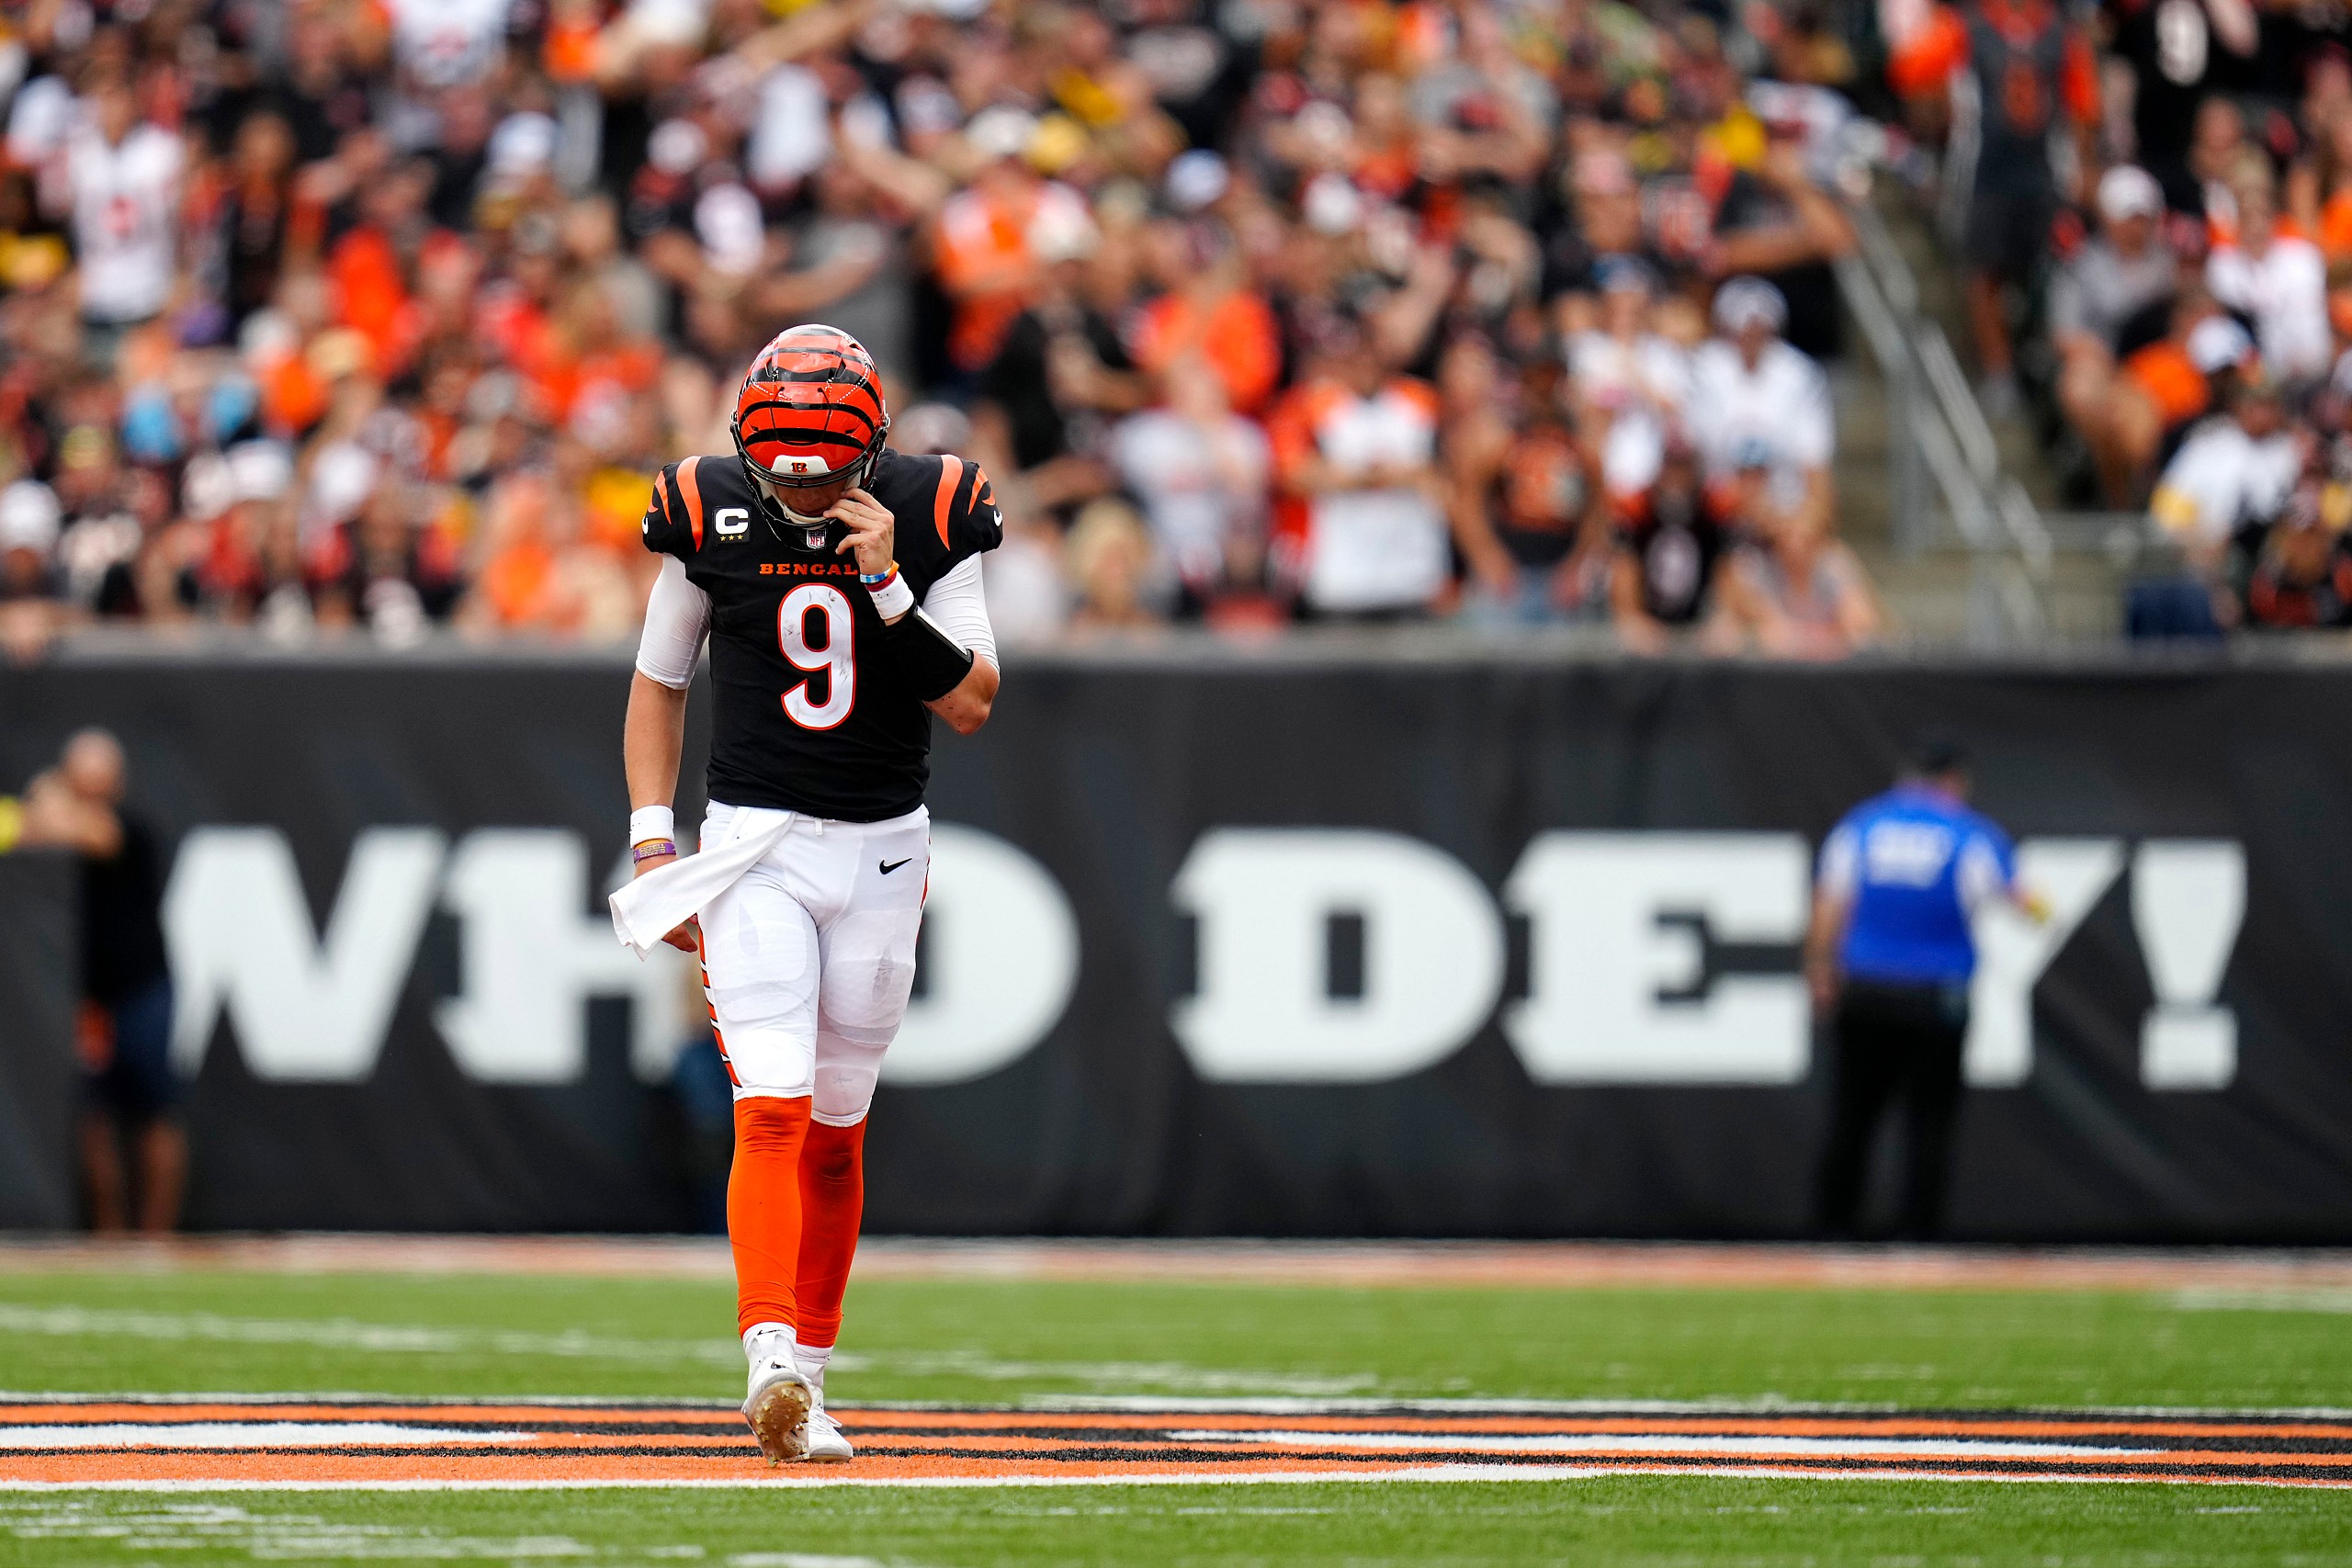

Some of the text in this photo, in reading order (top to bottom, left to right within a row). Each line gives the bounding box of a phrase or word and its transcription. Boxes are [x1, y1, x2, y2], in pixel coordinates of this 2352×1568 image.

[716, 508, 749, 535] C
[810, 536, 825, 546] NFL
[760, 564, 858, 575] BENGAL
[778, 582, 855, 730] 9
[1168, 827, 2248, 1091] DEY!
